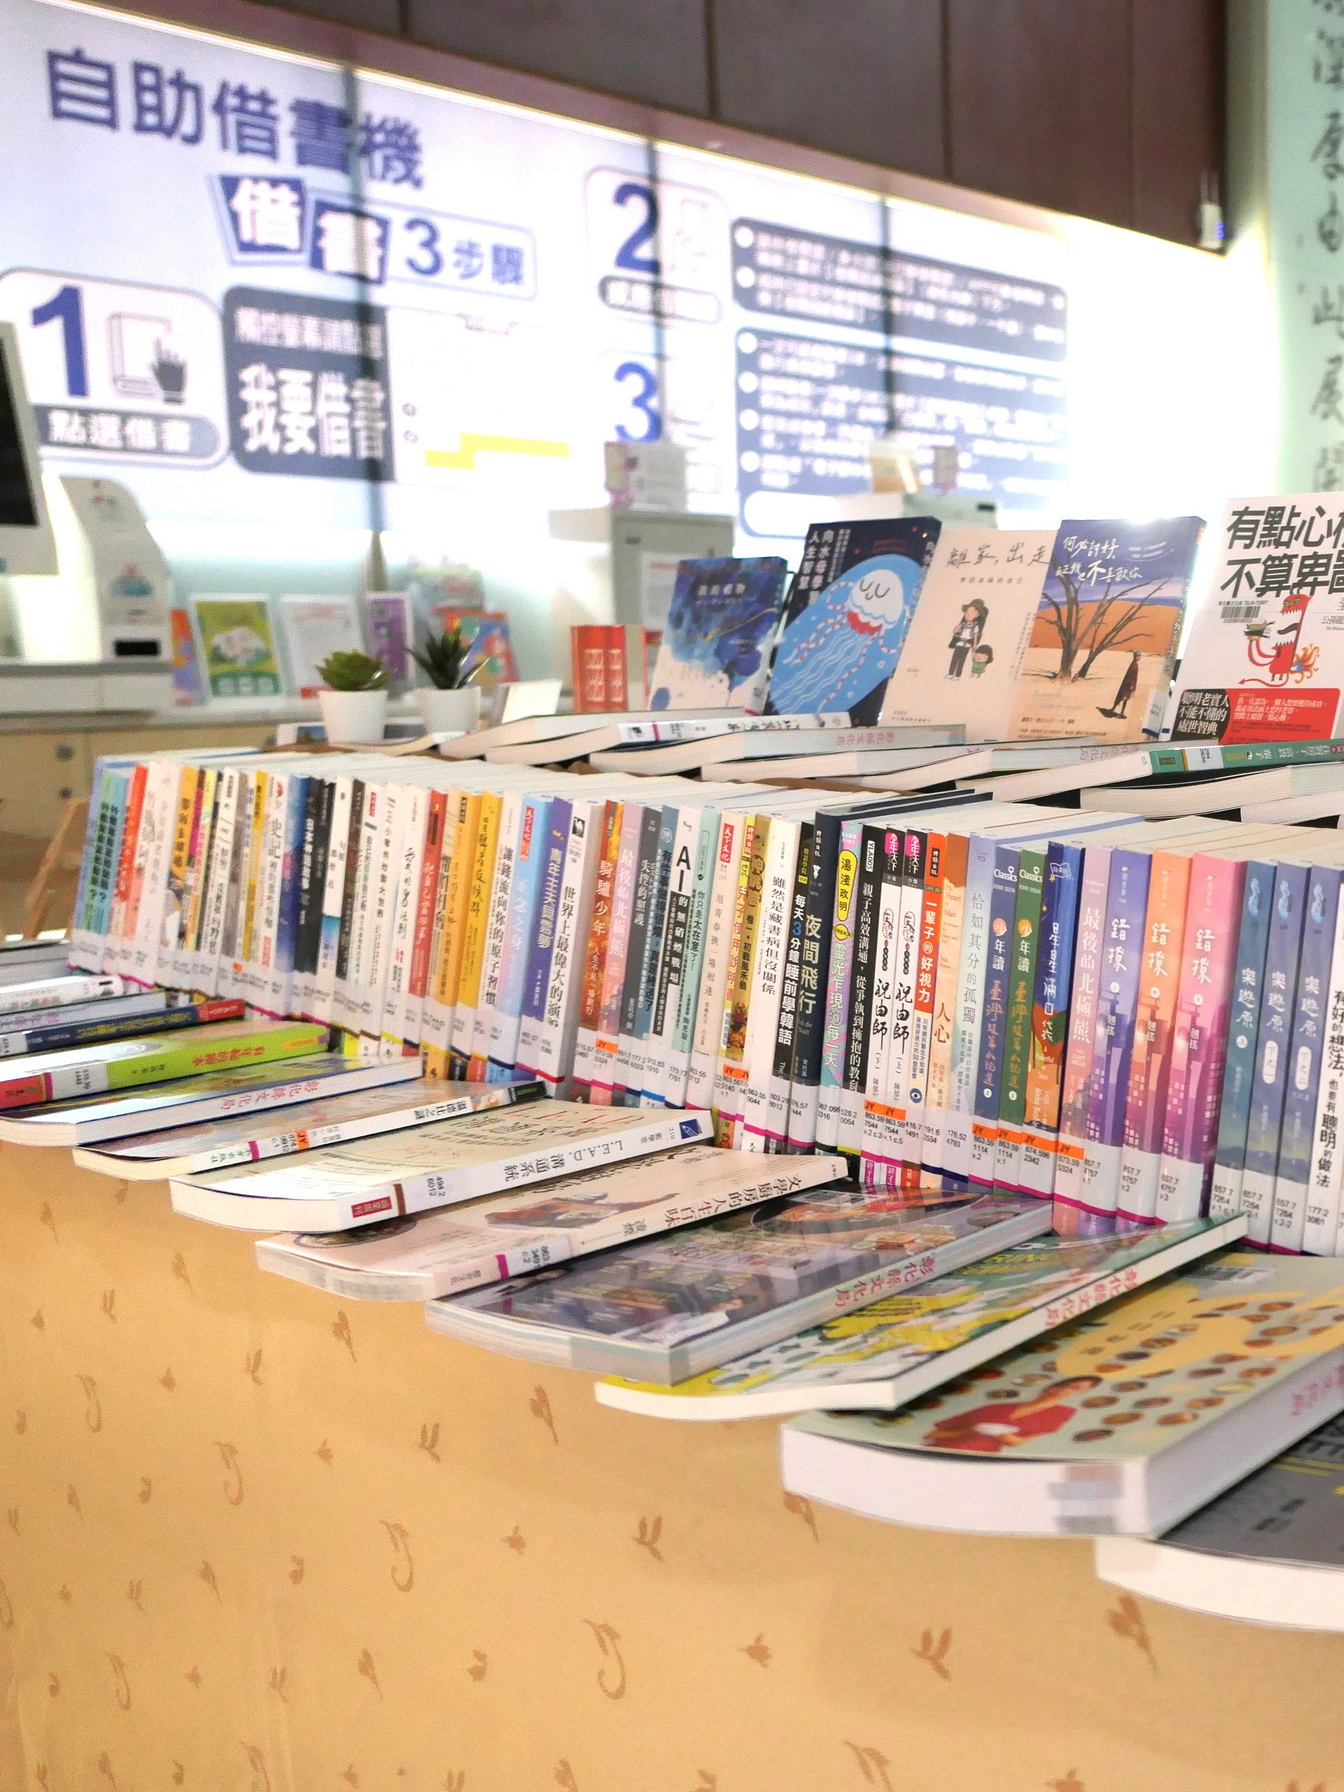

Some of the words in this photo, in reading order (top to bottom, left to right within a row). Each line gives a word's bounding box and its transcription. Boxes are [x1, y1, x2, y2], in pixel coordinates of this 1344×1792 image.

[46, 47, 425, 190] 自助借書機
[611, 183, 660, 274] 2
[31, 285, 87, 399] 1
[238, 361, 386, 460] 我要借書
[612, 360, 662, 443] 3
[1177, 721, 1217, 735] 處世智典
[1179, 706, 1227, 721] 不能不懂的
[1182, 692, 1229, 707] 聰明老實人
[721, 825, 733, 862] 天下文化
[887, 834, 898, 872] 少年天下
[907, 835, 919, 874] 少年天下
[591, 860, 614, 936] 騎驢少年
[610, 849, 633, 959] 最後的北極熊
[839, 858, 852, 911] 湯淺政明
[946, 892, 961, 902] Heart
[994, 868, 1018, 883] Classics
[1019, 868, 1042, 882] Classics
[486, 847, 514, 1007] 讓錢流向你的原子習慣
[762, 876, 786, 995] 雖然是藏書病但沒關係
[944, 907, 957, 917] Man
[778, 894, 807, 1046] 每天3分鐘睡前學韓語
[798, 914, 822, 1014] 夜間飛行
[918, 900, 938, 1004] 一輩子的好視力
[962, 894, 985, 1024] 恰如其分的孤獨
[992, 919, 1007, 972] 少年讀
[1018, 919, 1032, 973] 少年讀
[1073, 908, 1100, 1044] 最後的北極熊
[824, 944, 848, 1067] 靈光乍現的每一天
[872, 979, 892, 1050] 祝由師
[894, 982, 913, 1054] 祝由師
[933, 1003, 951, 1043] 人心
[1234, 967, 1256, 1028] 樂遊原
[1266, 970, 1285, 1033] 樂遊原
[1300, 975, 1320, 1038] 樂遊原
[865, 1120, 878, 1129] 7544
[974, 1144, 988, 1153] 1114
[505, 1154, 565, 1182] 溝通系統
[663, 1176, 802, 1228] 文學廚房的人生百味
